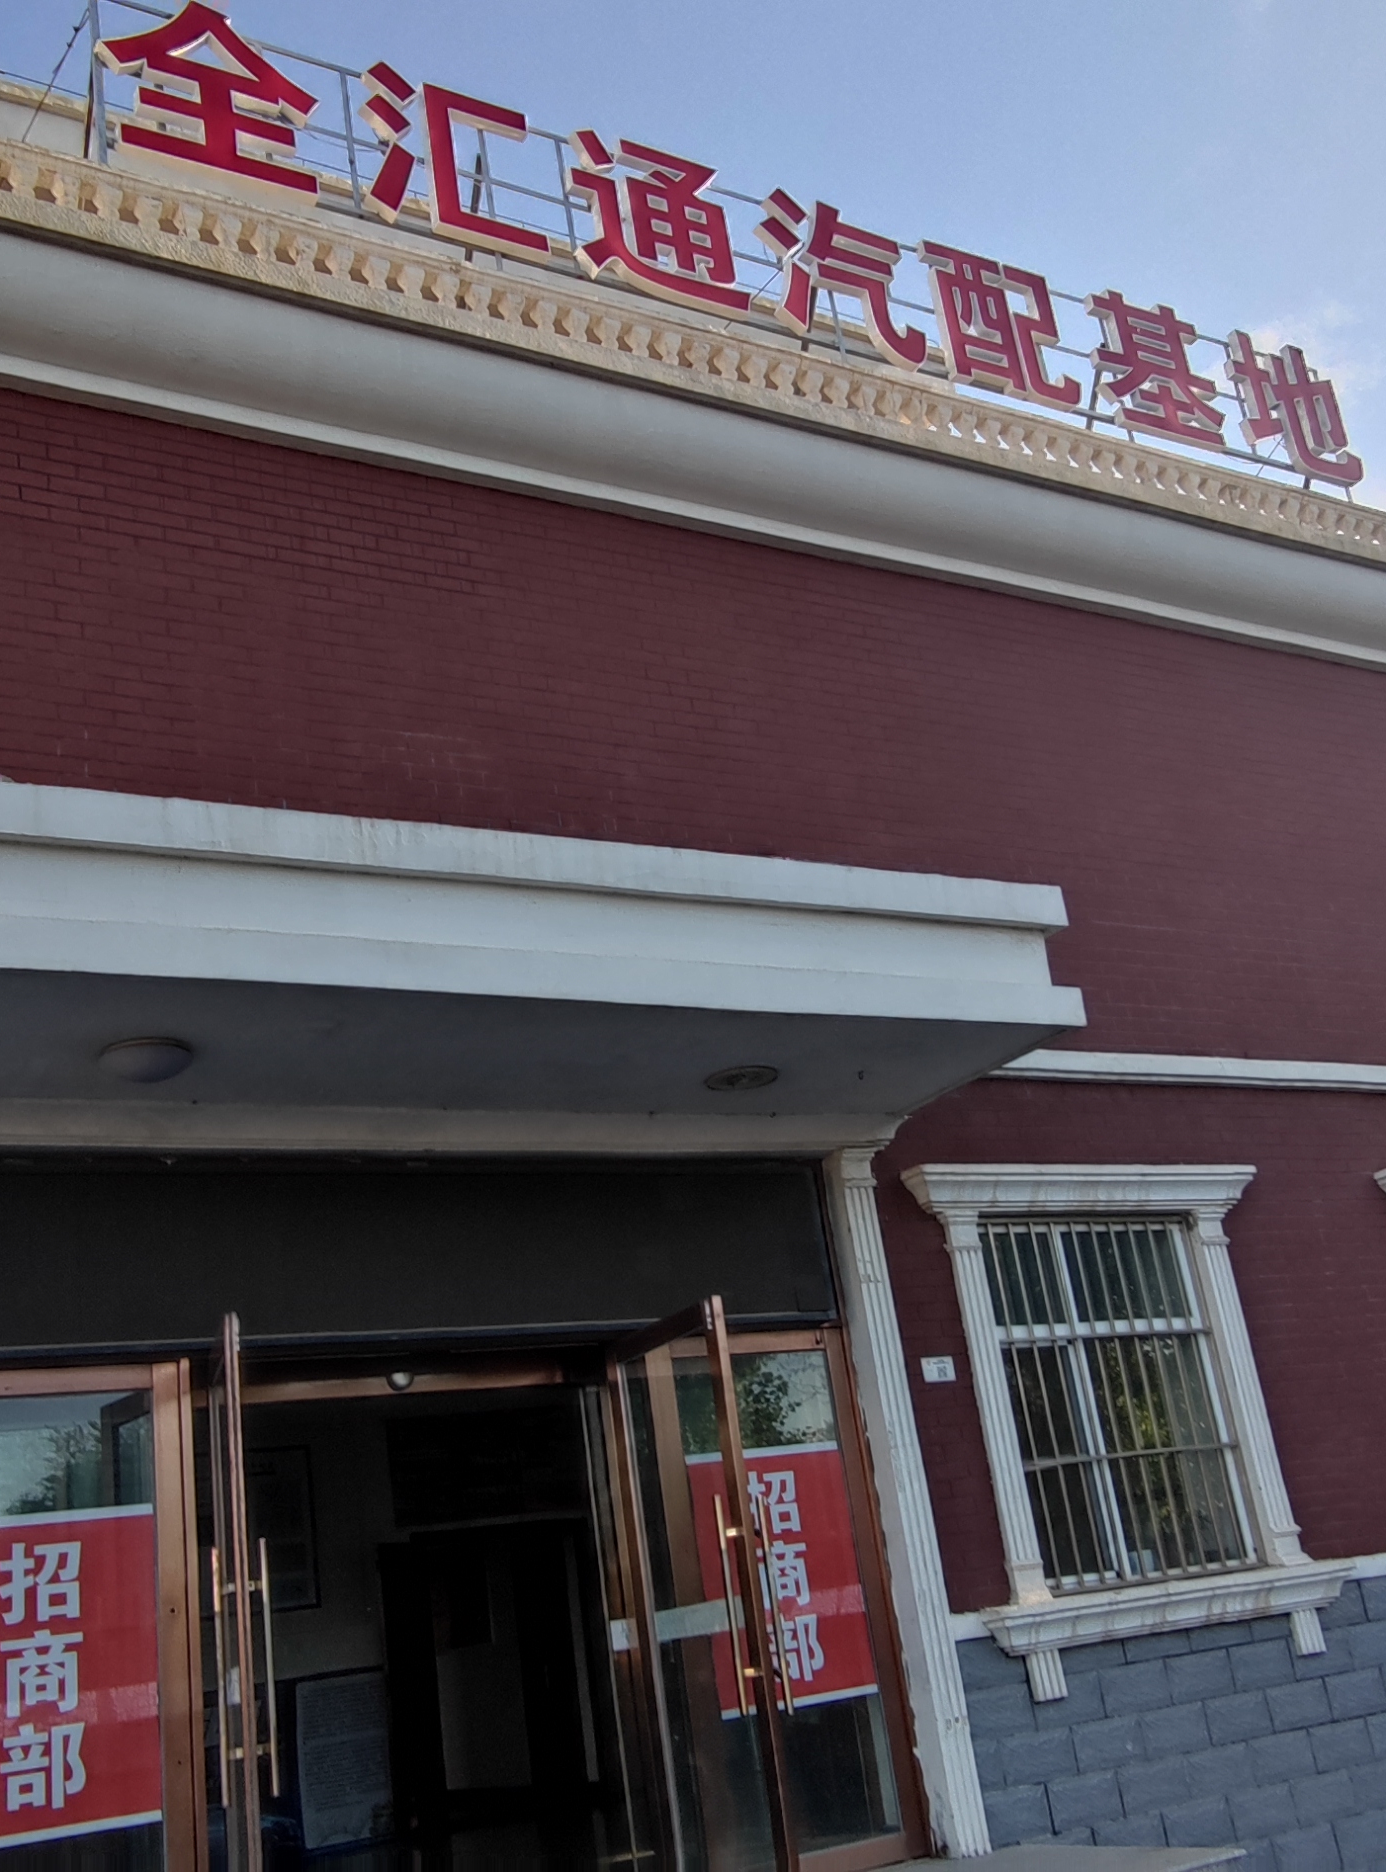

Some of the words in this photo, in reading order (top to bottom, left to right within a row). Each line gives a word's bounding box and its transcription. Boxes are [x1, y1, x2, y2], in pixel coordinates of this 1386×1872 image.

[95, 0, 1364, 488] 全汇通汽配基地
[747, 1470, 825, 1682] 招商部
